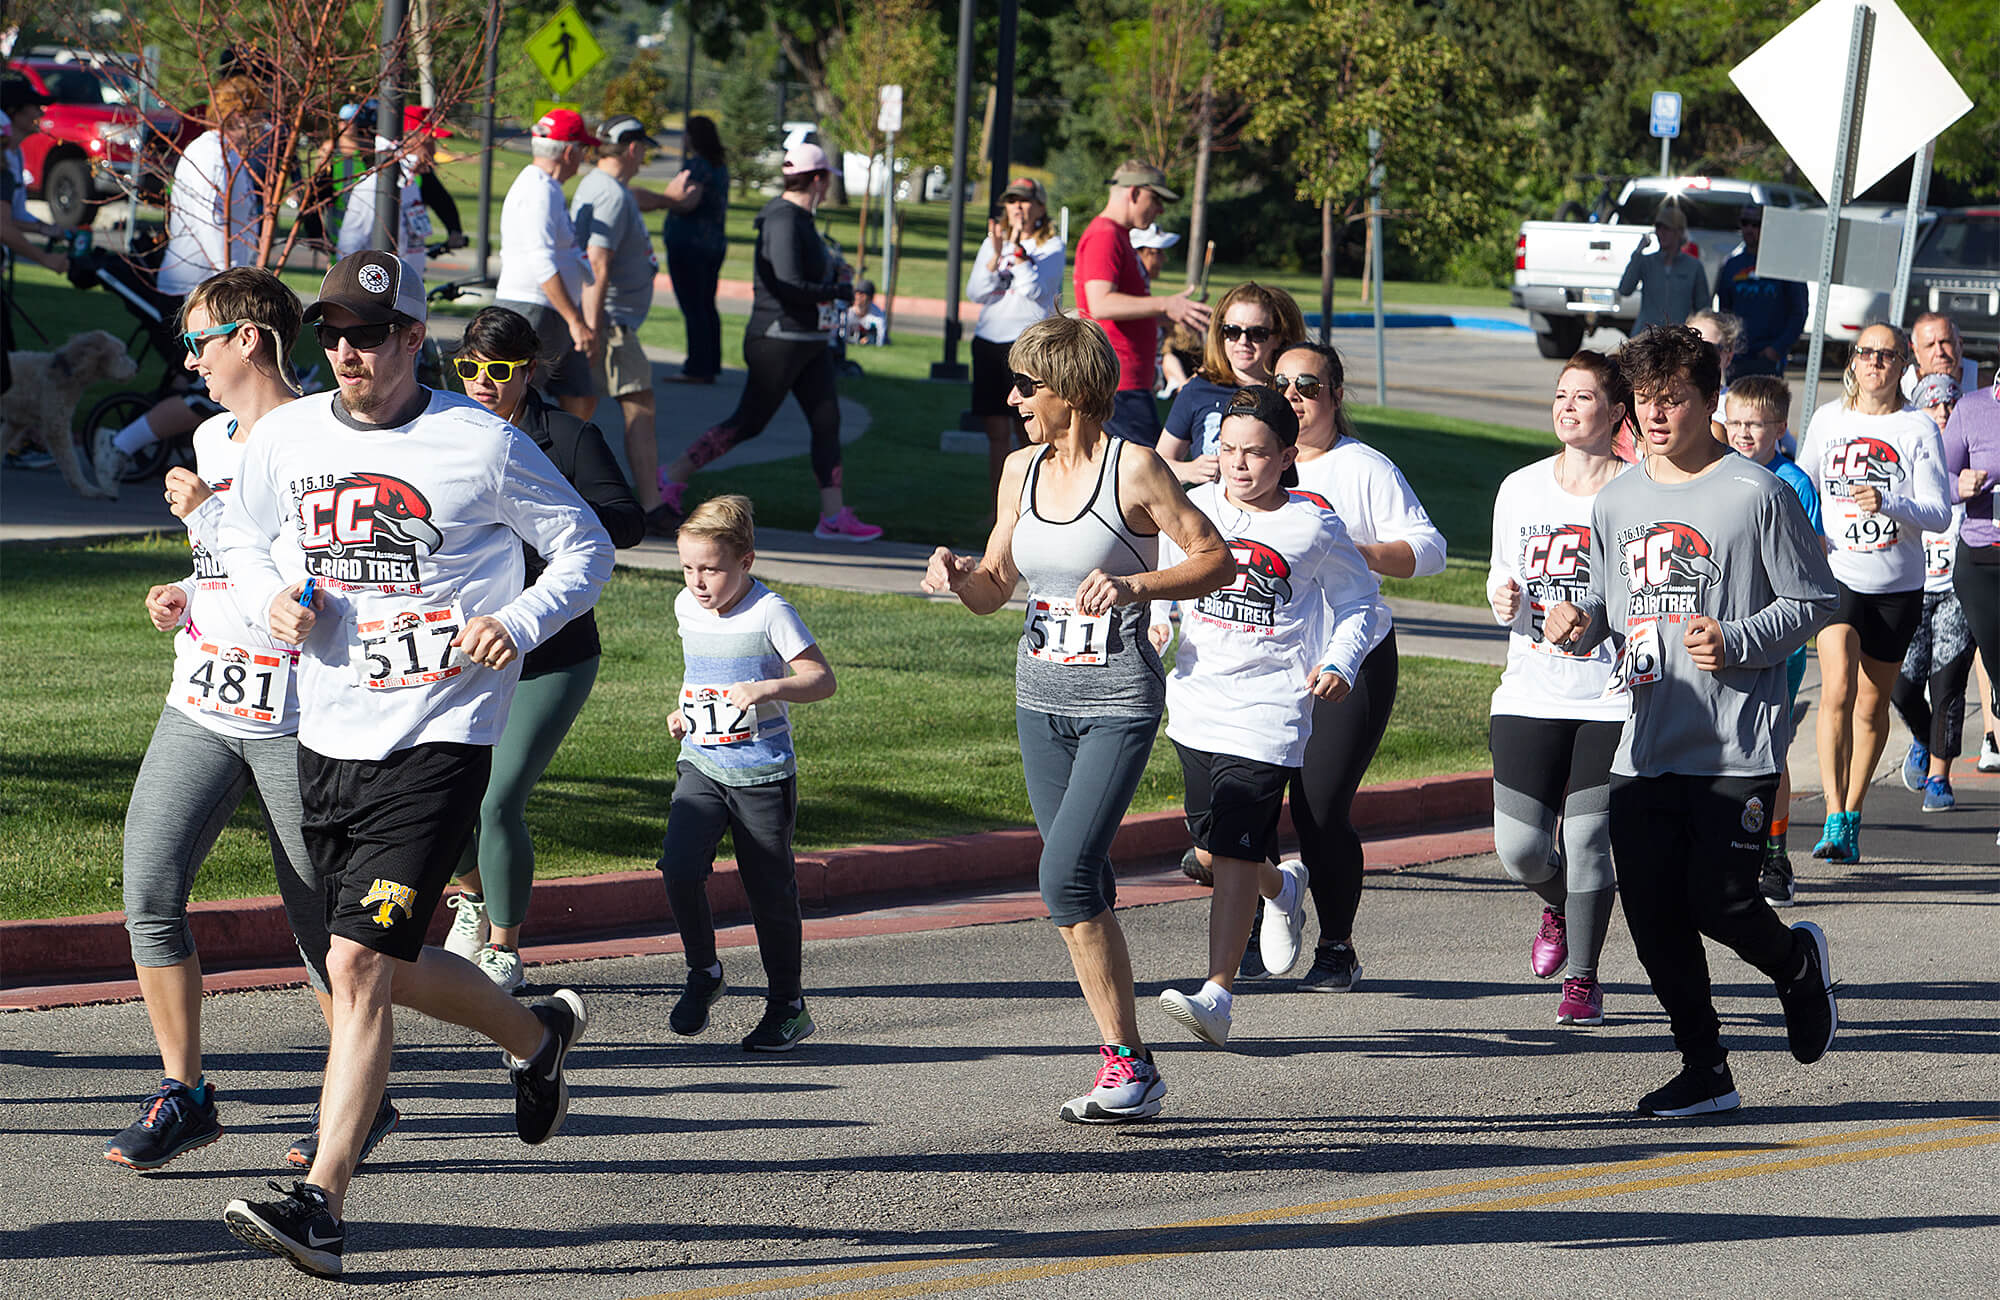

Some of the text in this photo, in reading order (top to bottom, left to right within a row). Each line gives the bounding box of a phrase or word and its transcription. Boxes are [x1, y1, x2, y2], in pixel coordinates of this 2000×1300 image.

[1825, 443, 1871, 478] CC
[290, 474, 334, 494] 9.15.19
[301, 485, 379, 549] CC
[1520, 524, 1551, 537] 9.15.19
[1845, 518, 1899, 545] 494
[307, 557, 416, 581] T-BIRD TREK
[1524, 533, 1581, 580] CC
[1625, 529, 1674, 594] CC
[410, 584, 424, 595] 5K
[1661, 593, 1697, 613] TREK
[1236, 604, 1271, 625] TREK
[1030, 615, 1098, 655] 511
[1265, 627, 1275, 636] 5K
[363, 624, 459, 680] 517
[189, 659, 274, 712] 481
[683, 702, 750, 734] 512
